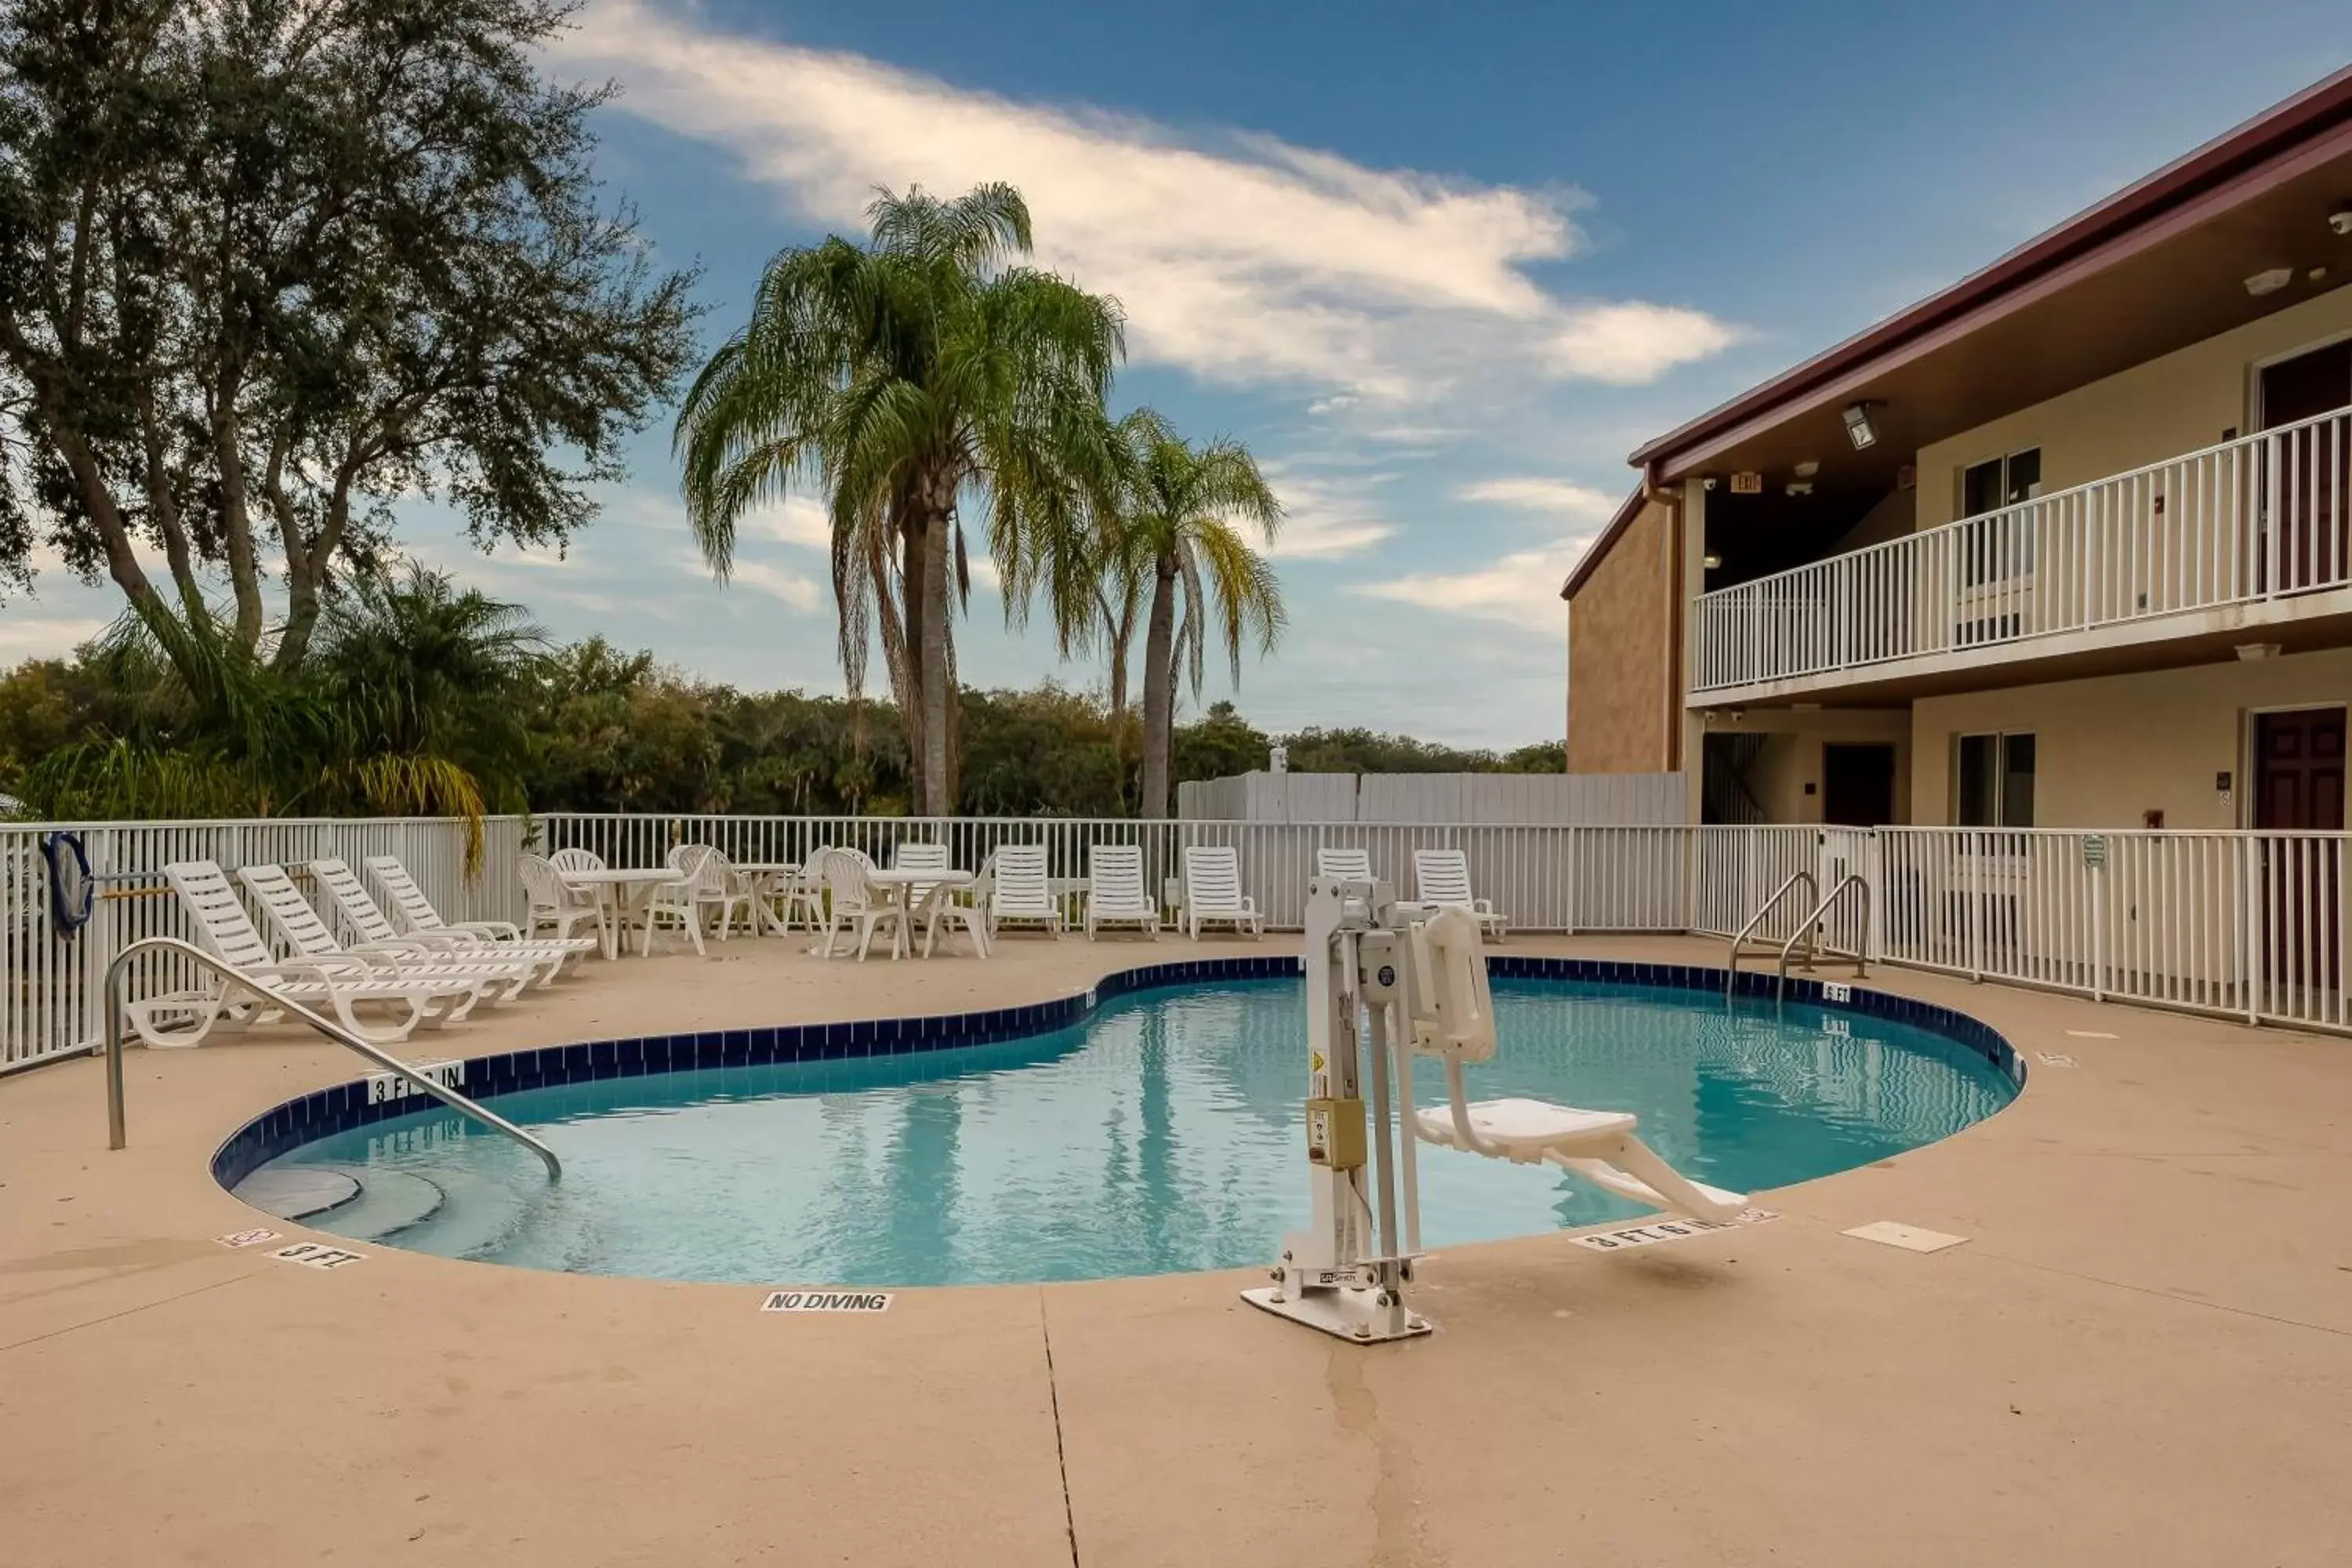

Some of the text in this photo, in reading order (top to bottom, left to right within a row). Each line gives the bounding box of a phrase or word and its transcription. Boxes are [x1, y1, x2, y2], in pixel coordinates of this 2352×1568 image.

[376, 1080, 385, 1102] 3
[441, 1066, 459, 1090] IN
[768, 1294, 887, 1310] NO DIVING
